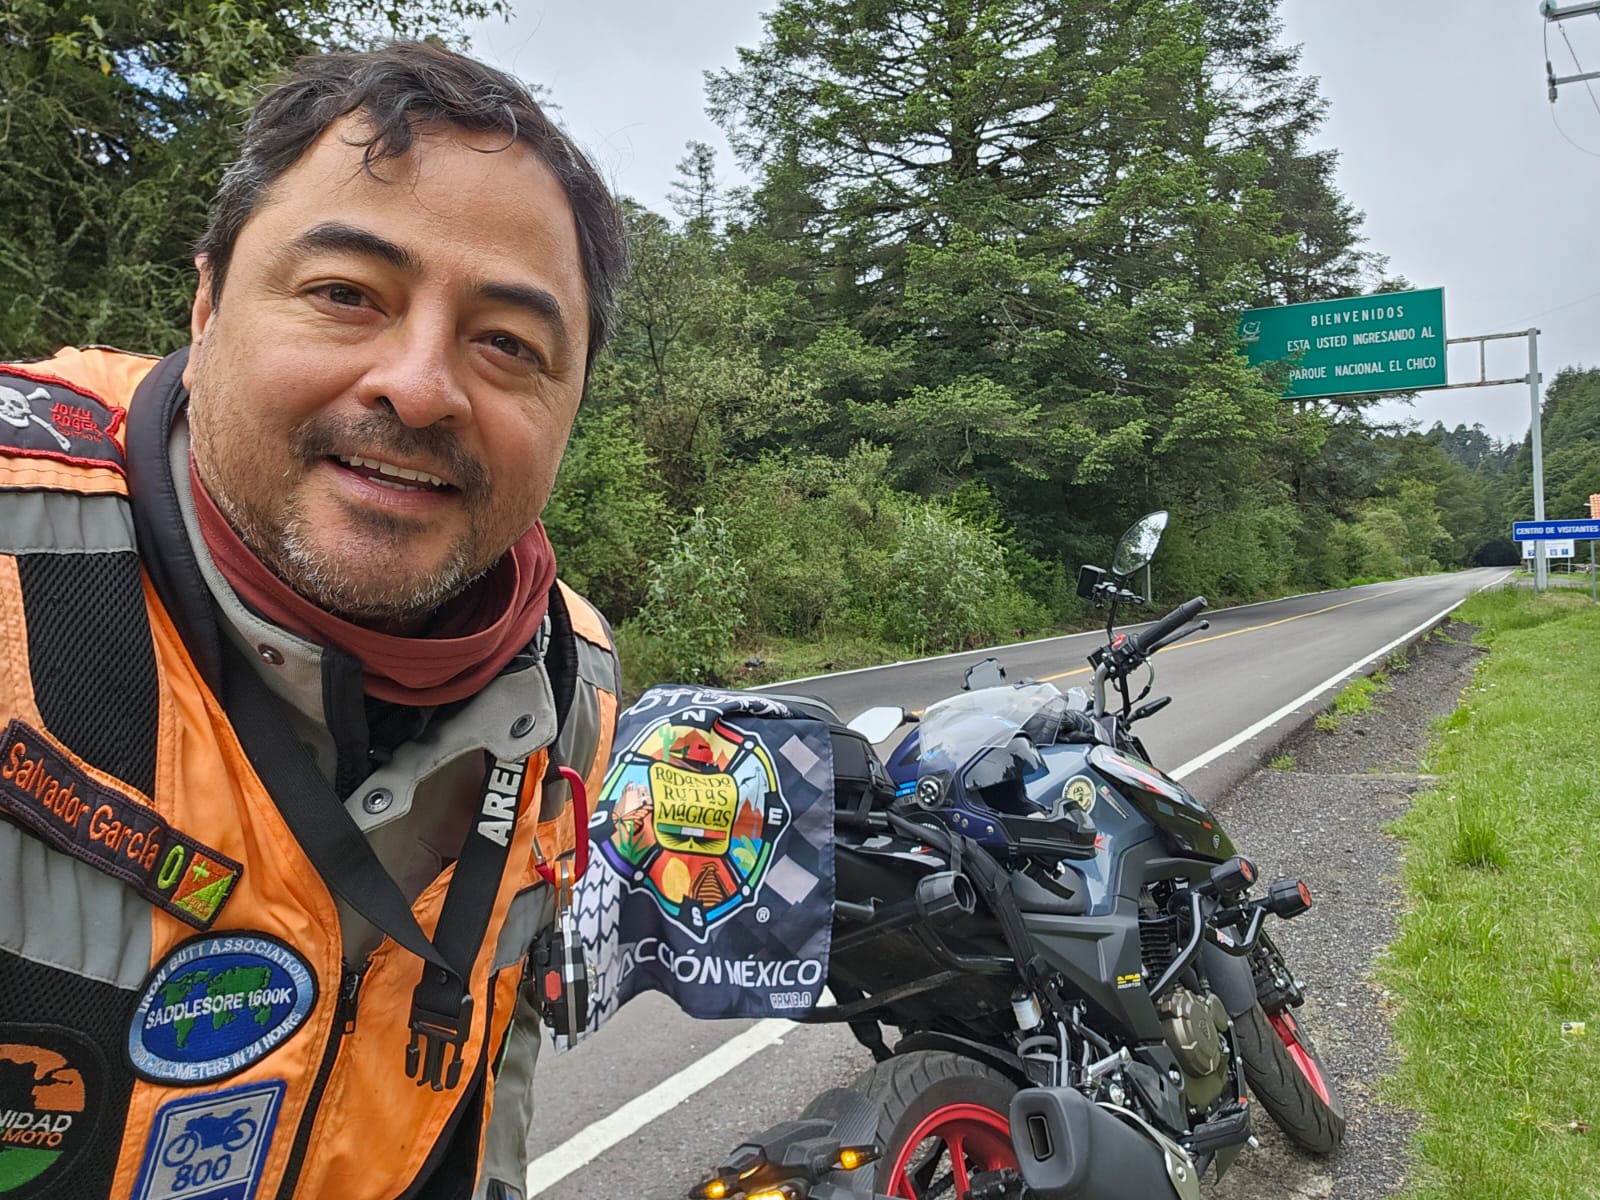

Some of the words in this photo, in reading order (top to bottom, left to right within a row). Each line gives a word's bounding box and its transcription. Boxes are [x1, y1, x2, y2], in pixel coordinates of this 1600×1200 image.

[1311, 306, 1404, 327] BIENVENIDOS
[1287, 339, 1311, 352] ESTA
[1316, 335, 1347, 349] USTED
[1353, 328, 1415, 345] INGRESANDO
[1421, 326, 1435, 338] AL
[1289, 366, 1327, 381] PARQUE
[1335, 360, 1384, 377] NACIONAL
[1390, 359, 1402, 371] EL
[1407, 356, 1436, 370] CHICO
[51, 413, 102, 436] ROGER
[1545, 526, 1555, 534] DE
[3, 742, 90, 828] Salvador
[89, 804, 160, 871] García
[137, 970, 166, 1014] IRON
[170, 943, 207, 971] BUTT
[210, 939, 308, 984] ASSOCIATION
[617, 937, 722, 988] ACCIÓN
[725, 955, 822, 988] MÉXICO
[145, 993, 244, 1030] SADDLESORE
[248, 987, 294, 1007] 1600K
[232, 1051, 246, 1069] IN
[247, 1041, 262, 1058] 24
[262, 1011, 302, 1049] HOURS
[171, 1154, 231, 1192] 800
